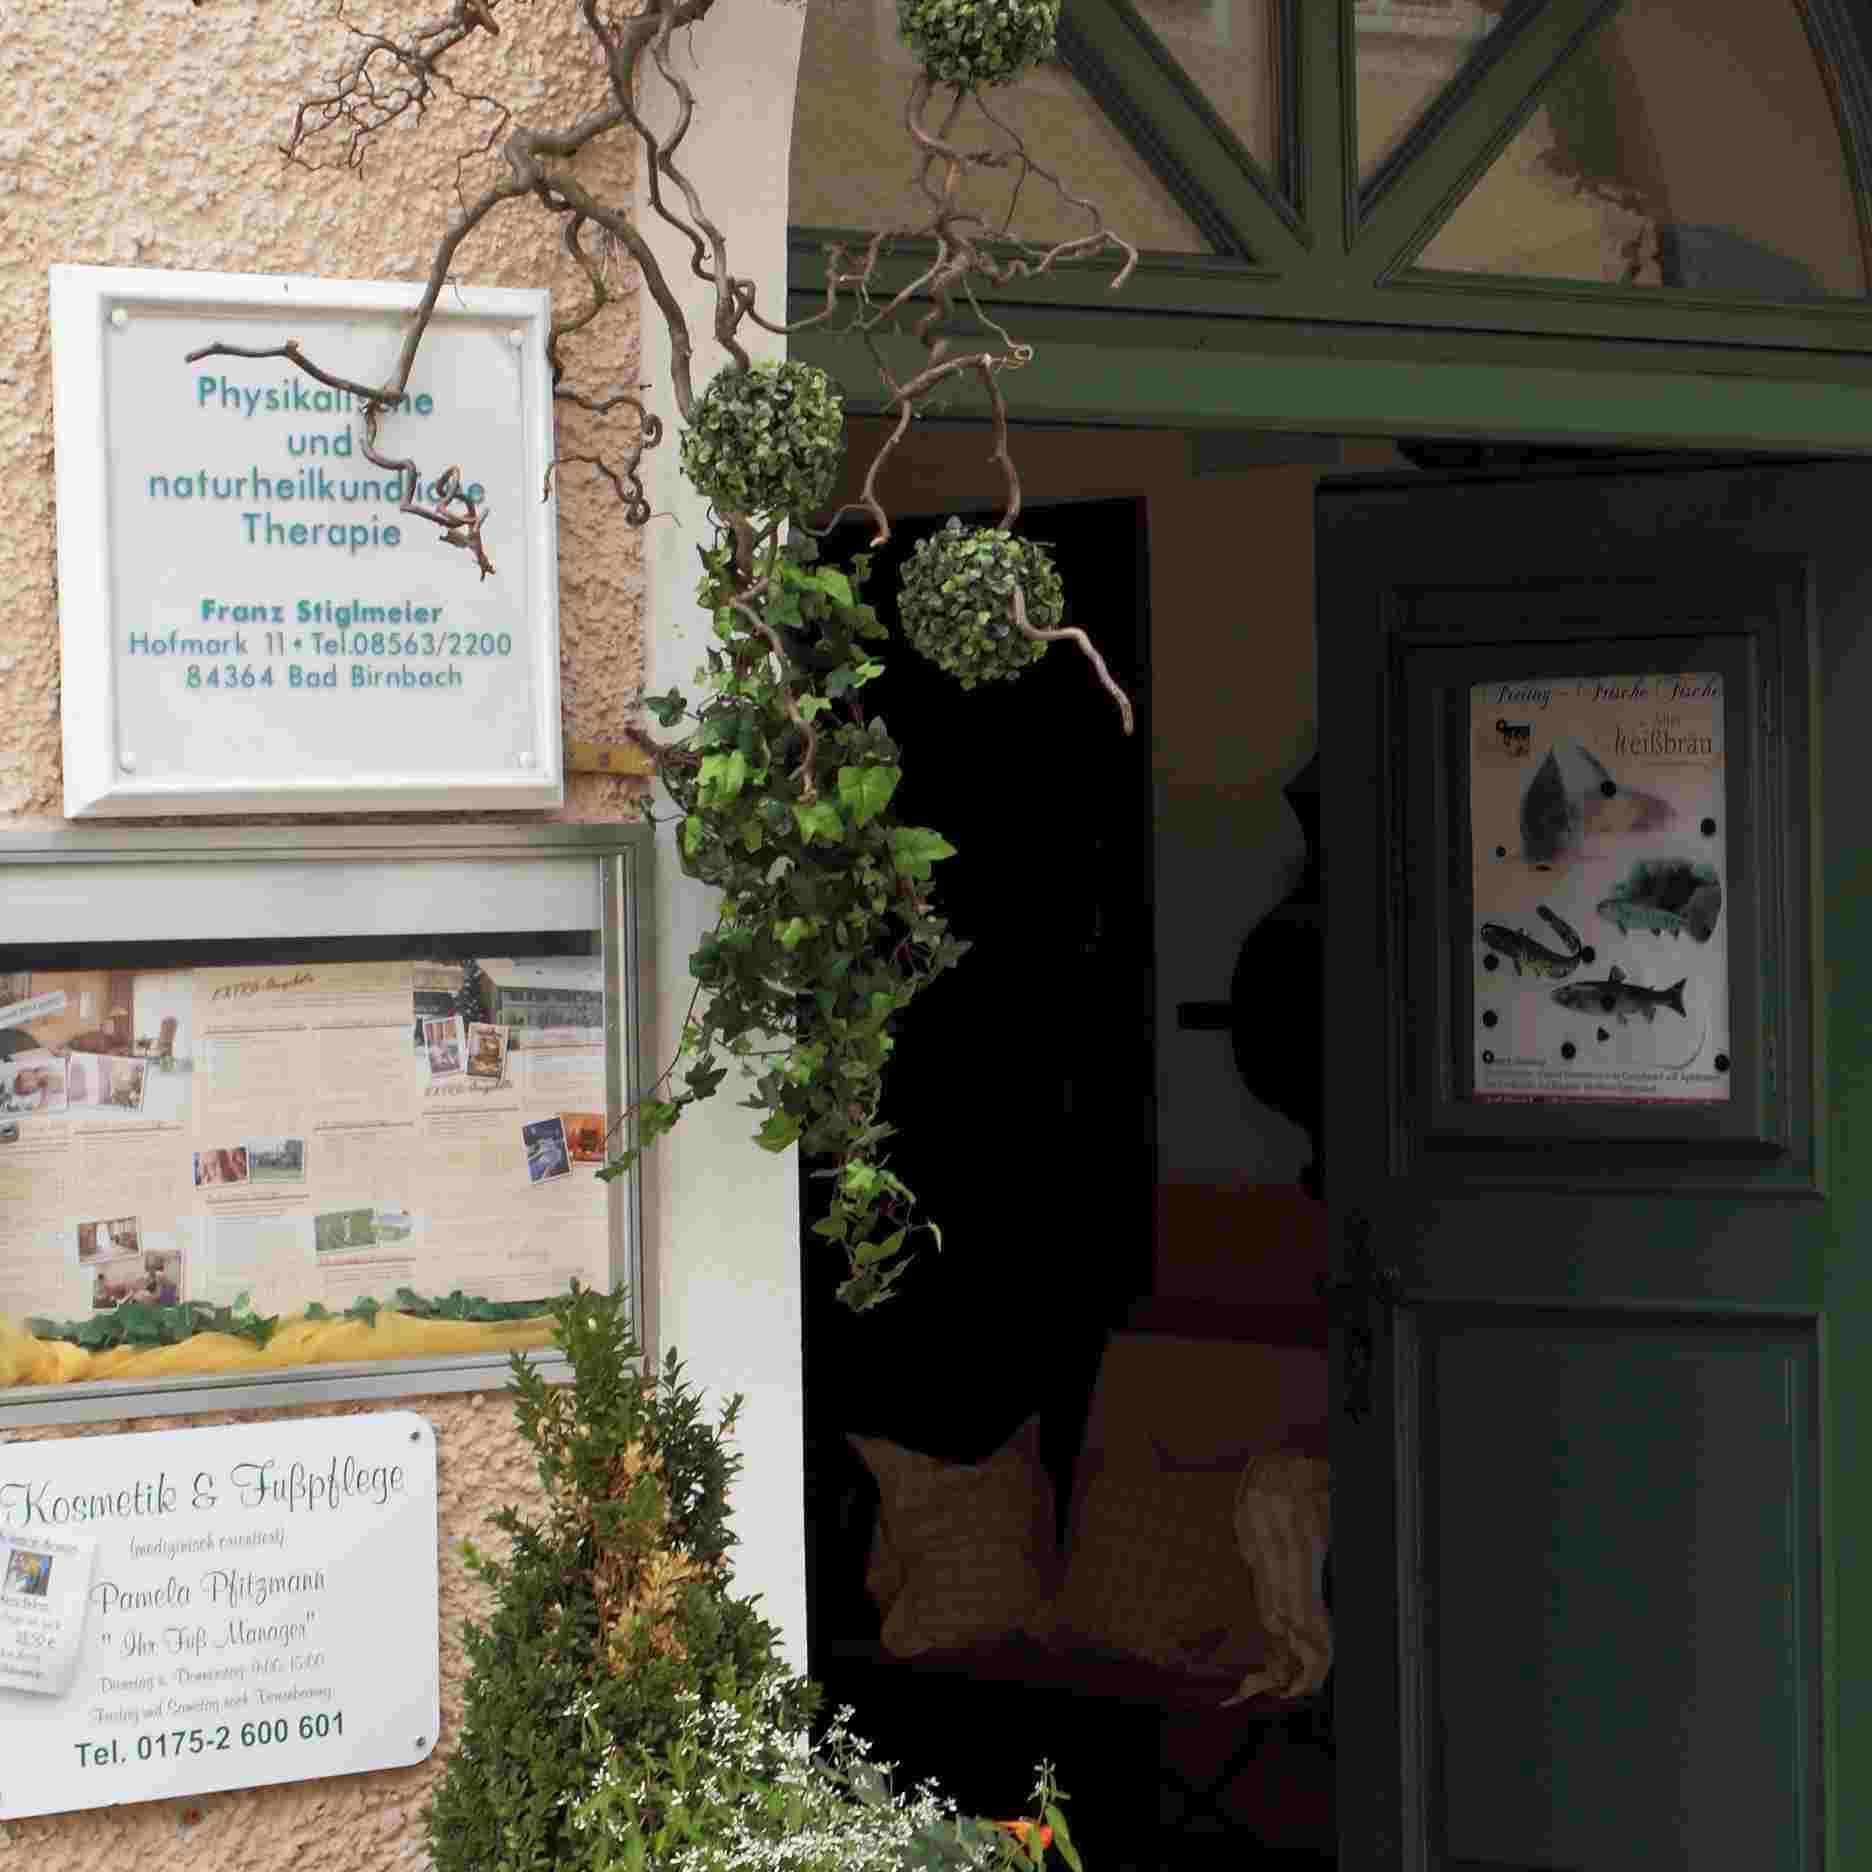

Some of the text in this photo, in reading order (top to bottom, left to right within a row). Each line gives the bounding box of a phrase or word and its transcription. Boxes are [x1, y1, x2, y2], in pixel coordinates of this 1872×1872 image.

[198, 375, 435, 418] Physikalihe
[287, 424, 353, 457] und
[241, 512, 402, 554] Therapie
[200, 599, 444, 628] Franz Stiglmeier
[128, 631, 248, 656] Hofmark
[264, 631, 286, 656] 11
[185, 664, 464, 689] 84364 Bad Birnbach
[0, 1455, 405, 1527] Kosmetik & Fußpflege
[89, 1568, 328, 1615] Pamela Pfitzmann
[75, 1711, 344, 1769] Tel. 0175-2 600 601
